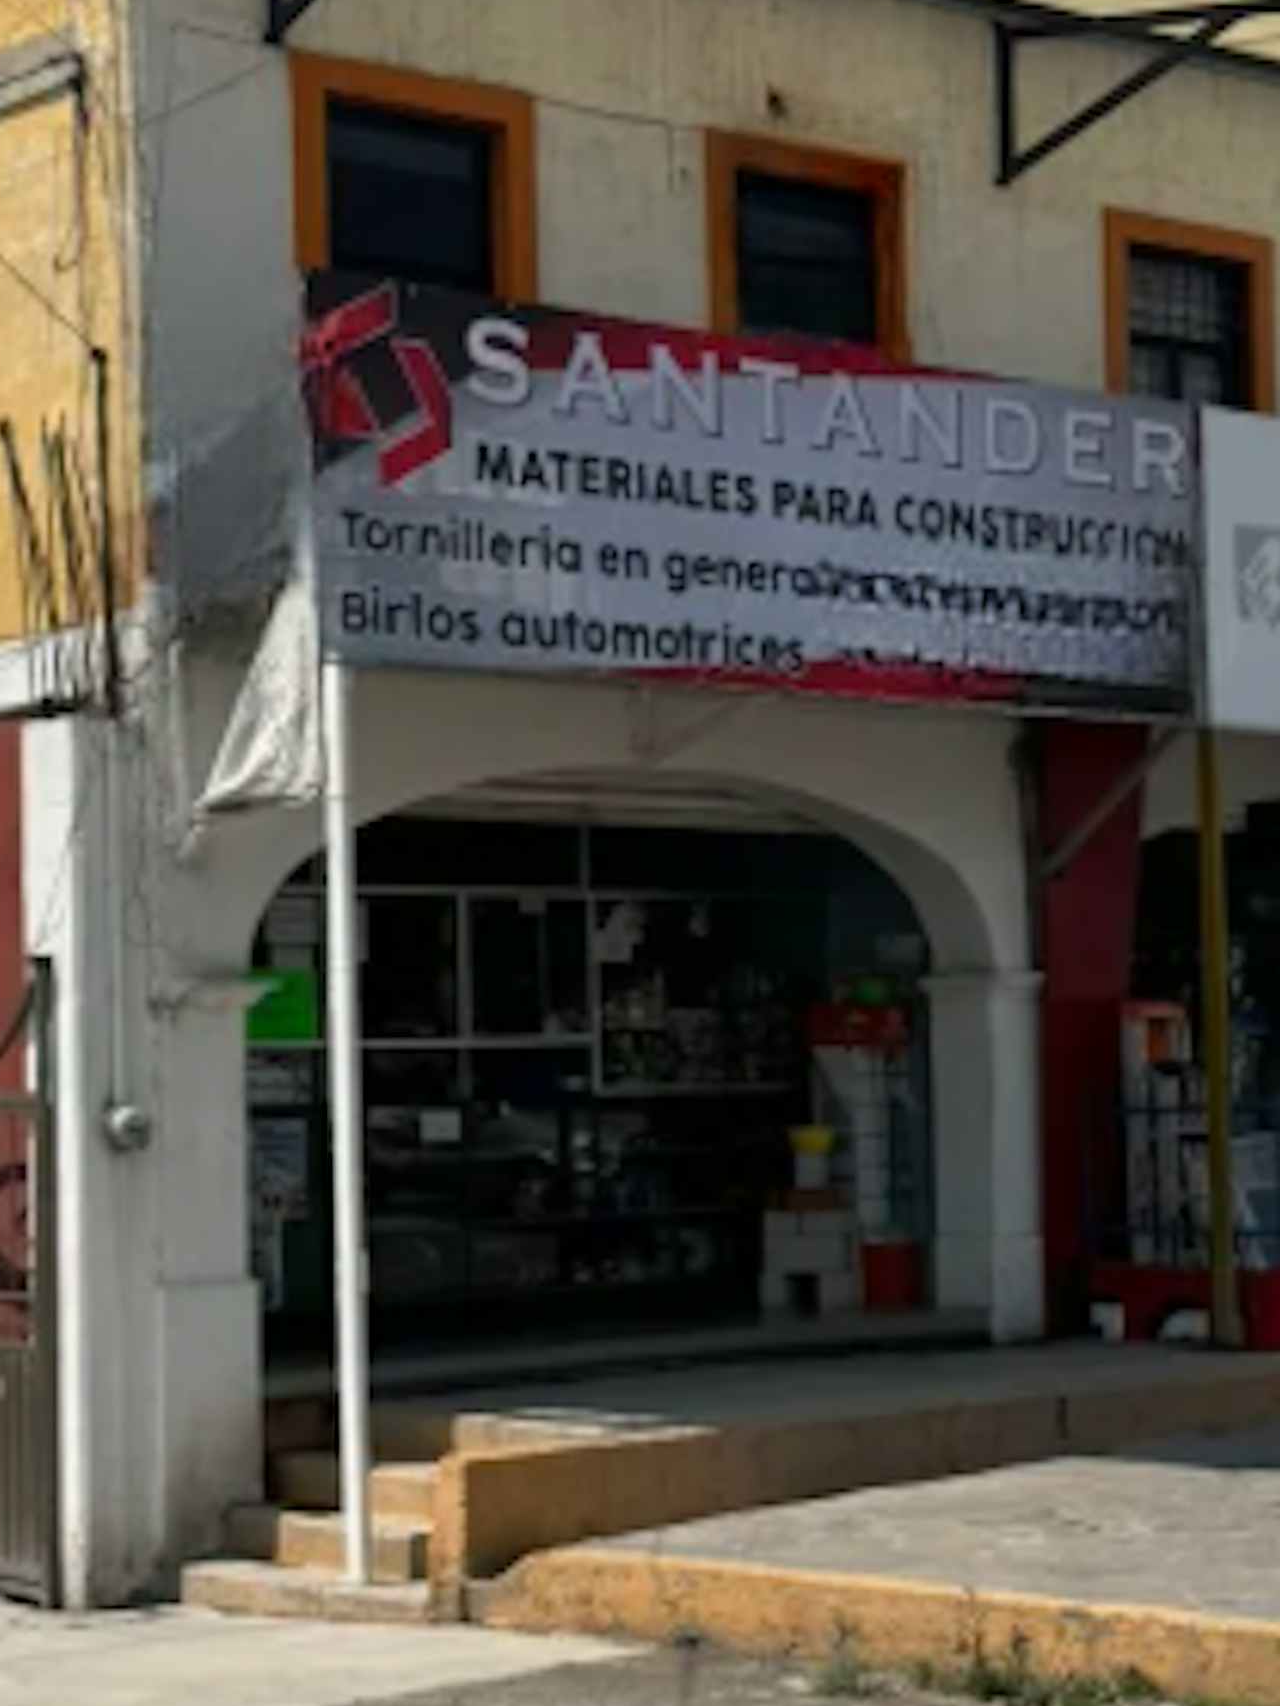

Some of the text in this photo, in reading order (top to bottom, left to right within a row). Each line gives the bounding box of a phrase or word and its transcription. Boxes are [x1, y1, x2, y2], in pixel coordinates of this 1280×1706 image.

[465, 317, 1188, 500] SANTANDER
[475, 438, 760, 518] MATERIALES
[771, 480, 877, 531] PARA
[598, 545, 650, 580] en
[664, 549, 832, 598] genera
[340, 586, 482, 644] Birlos
[501, 607, 805, 671] automotrices
